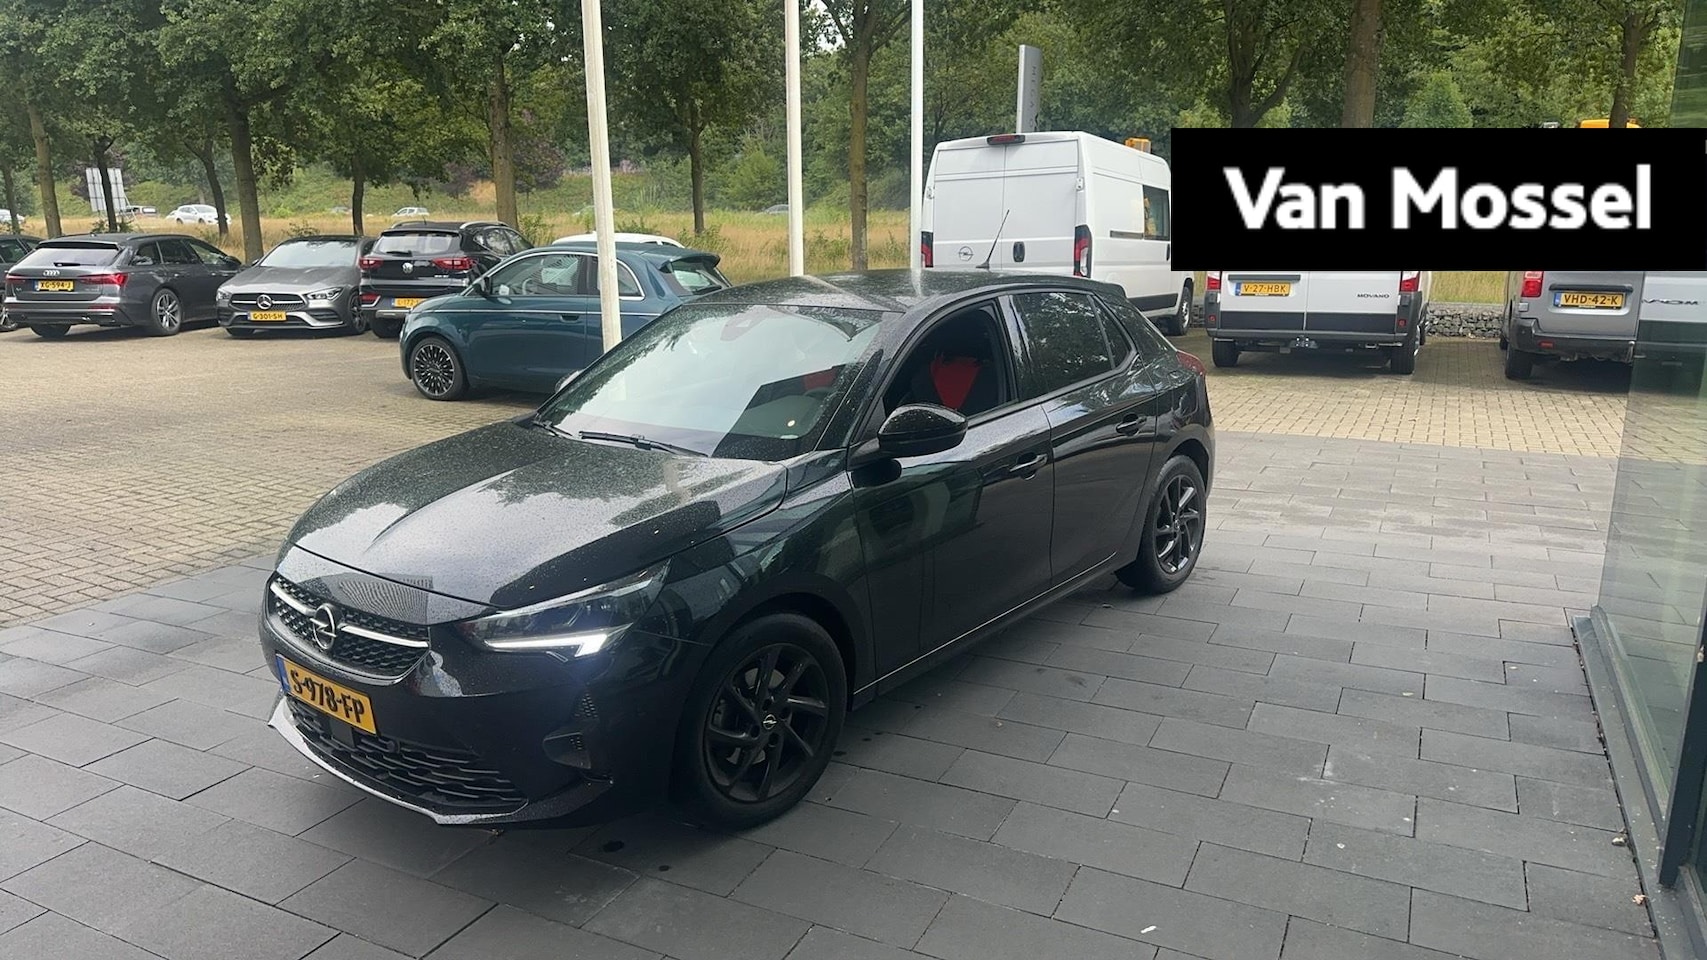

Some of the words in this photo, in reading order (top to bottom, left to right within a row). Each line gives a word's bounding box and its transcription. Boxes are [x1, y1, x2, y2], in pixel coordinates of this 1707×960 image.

[1243, 284, 1287, 293] V-27-HBK
[1563, 294, 1618, 305] VHD-42-K
[290, 669, 365, 724] S-978-FP
